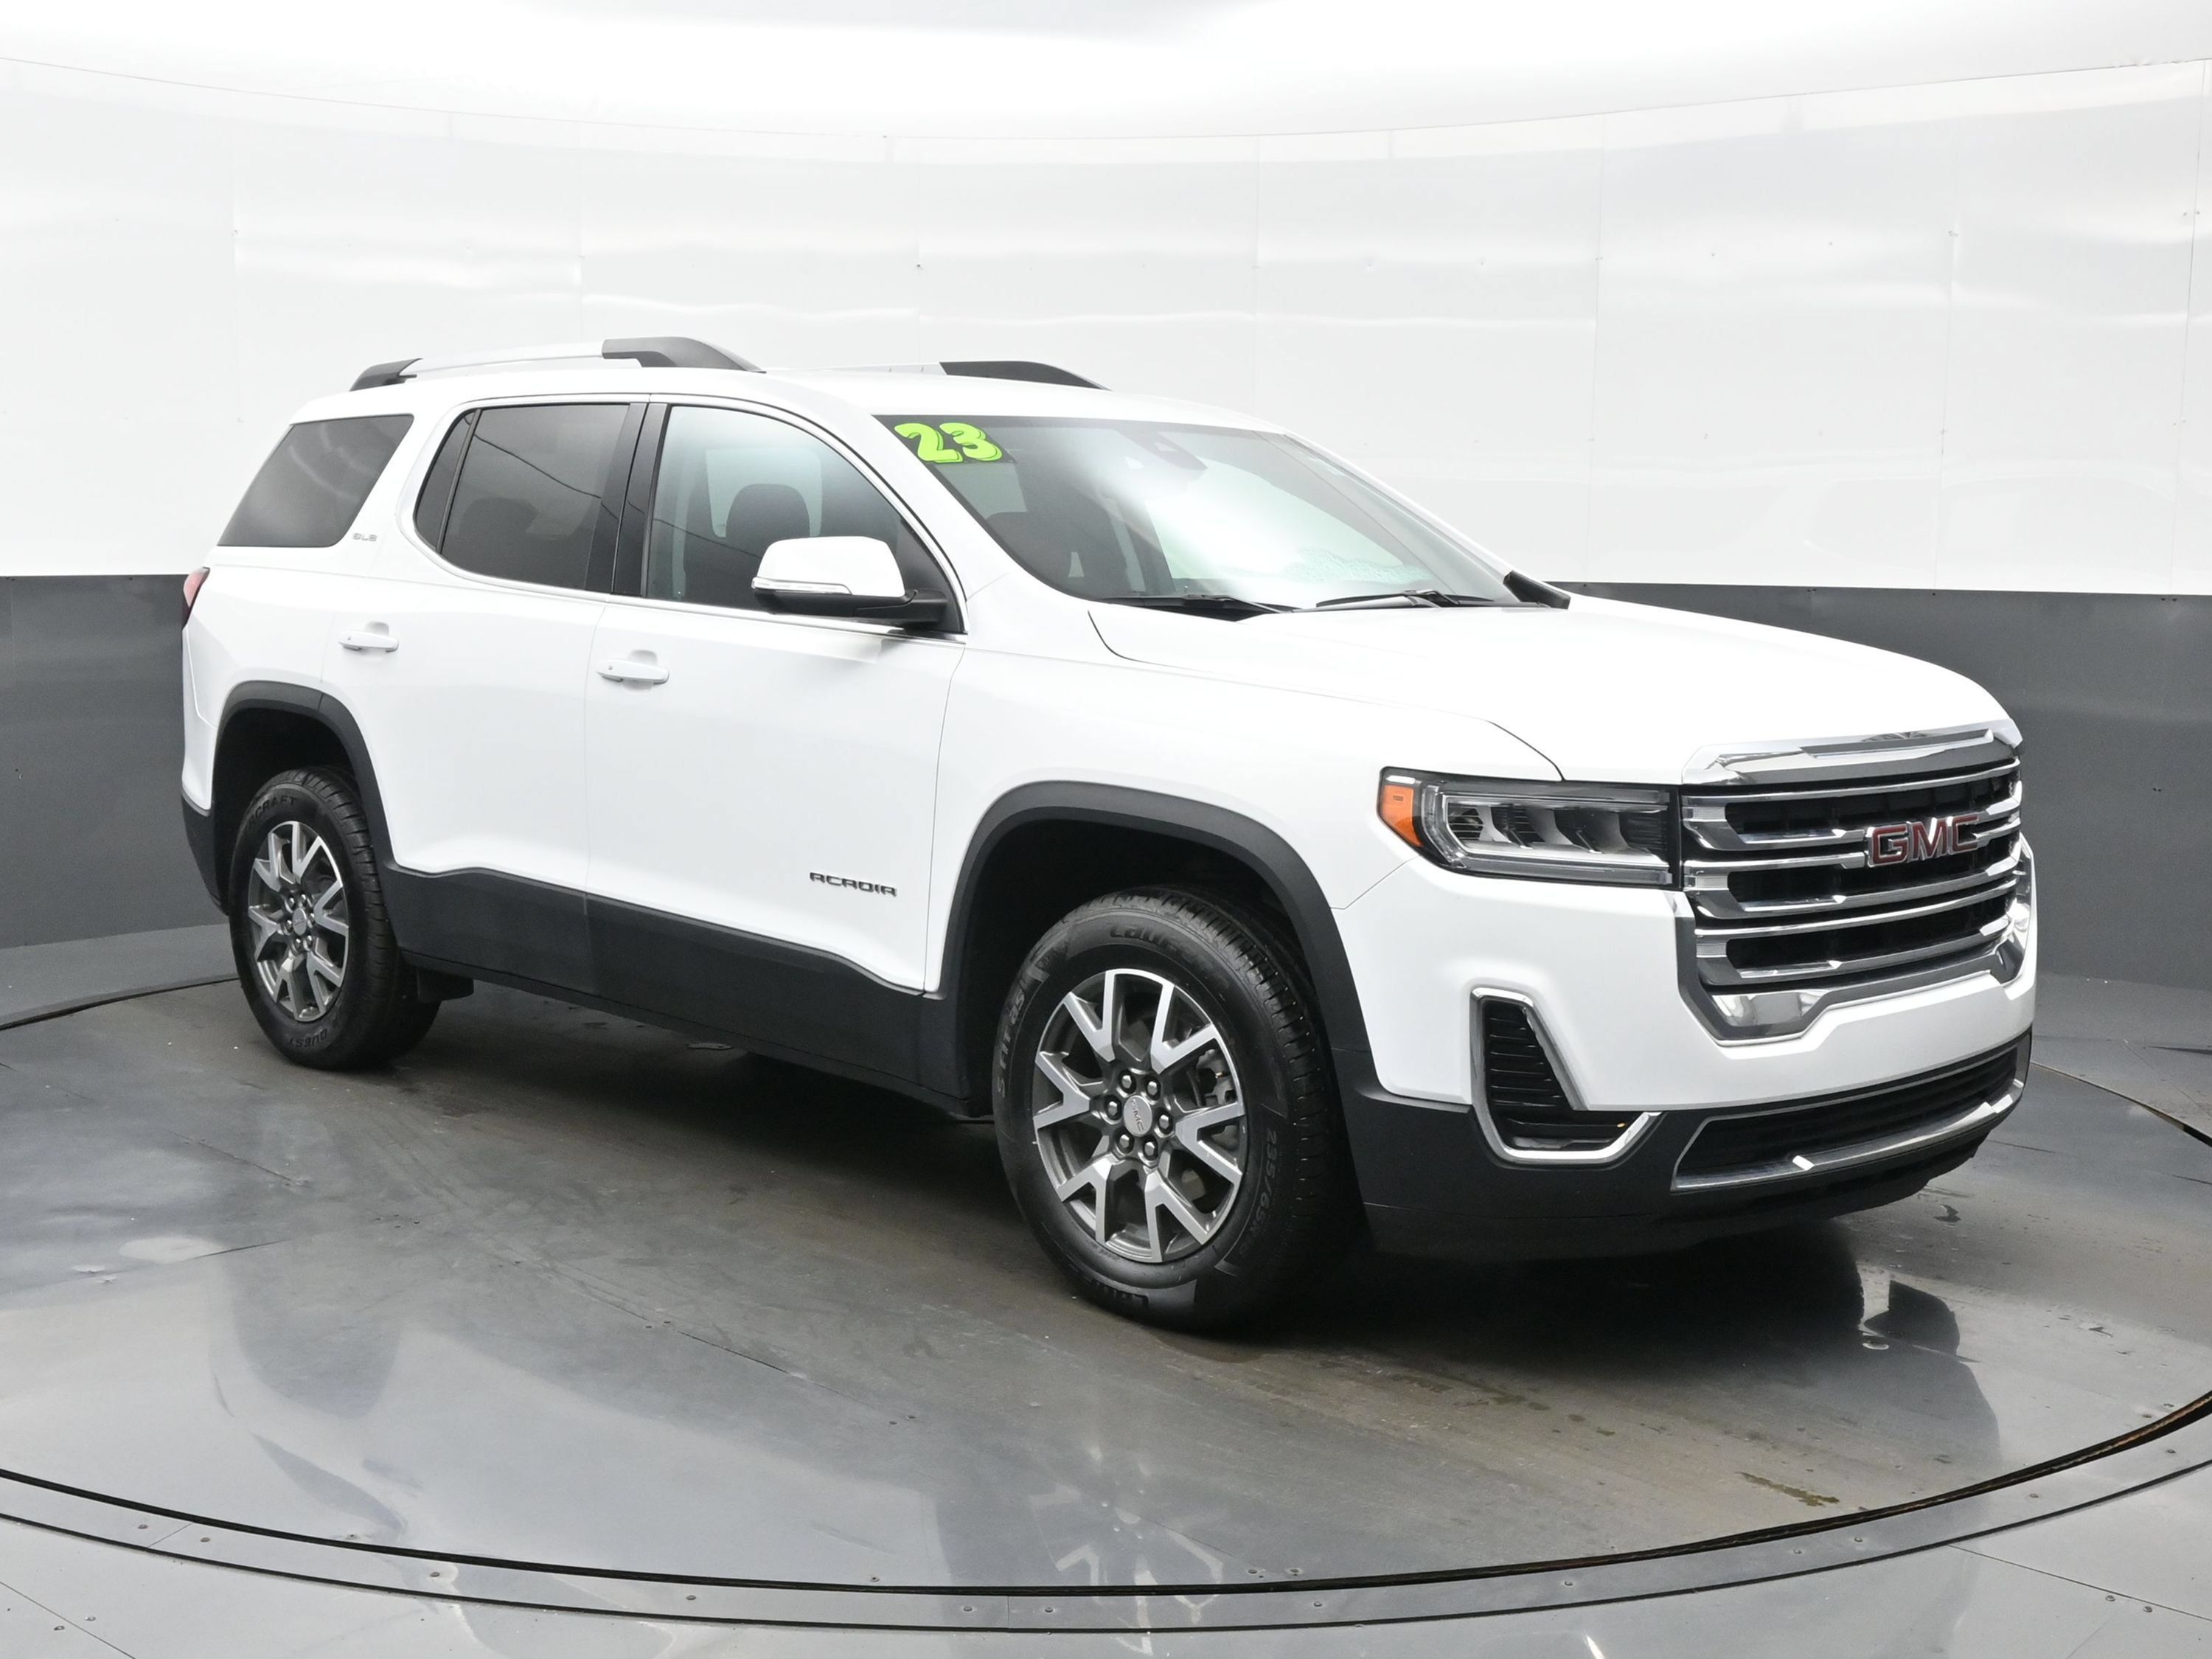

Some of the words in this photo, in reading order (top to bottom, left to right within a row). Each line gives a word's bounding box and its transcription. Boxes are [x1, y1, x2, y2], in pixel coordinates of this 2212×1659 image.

[894, 422, 1003, 463] 23
[1865, 815, 1980, 868] GMC
[809, 872, 897, 897] ACADIA
